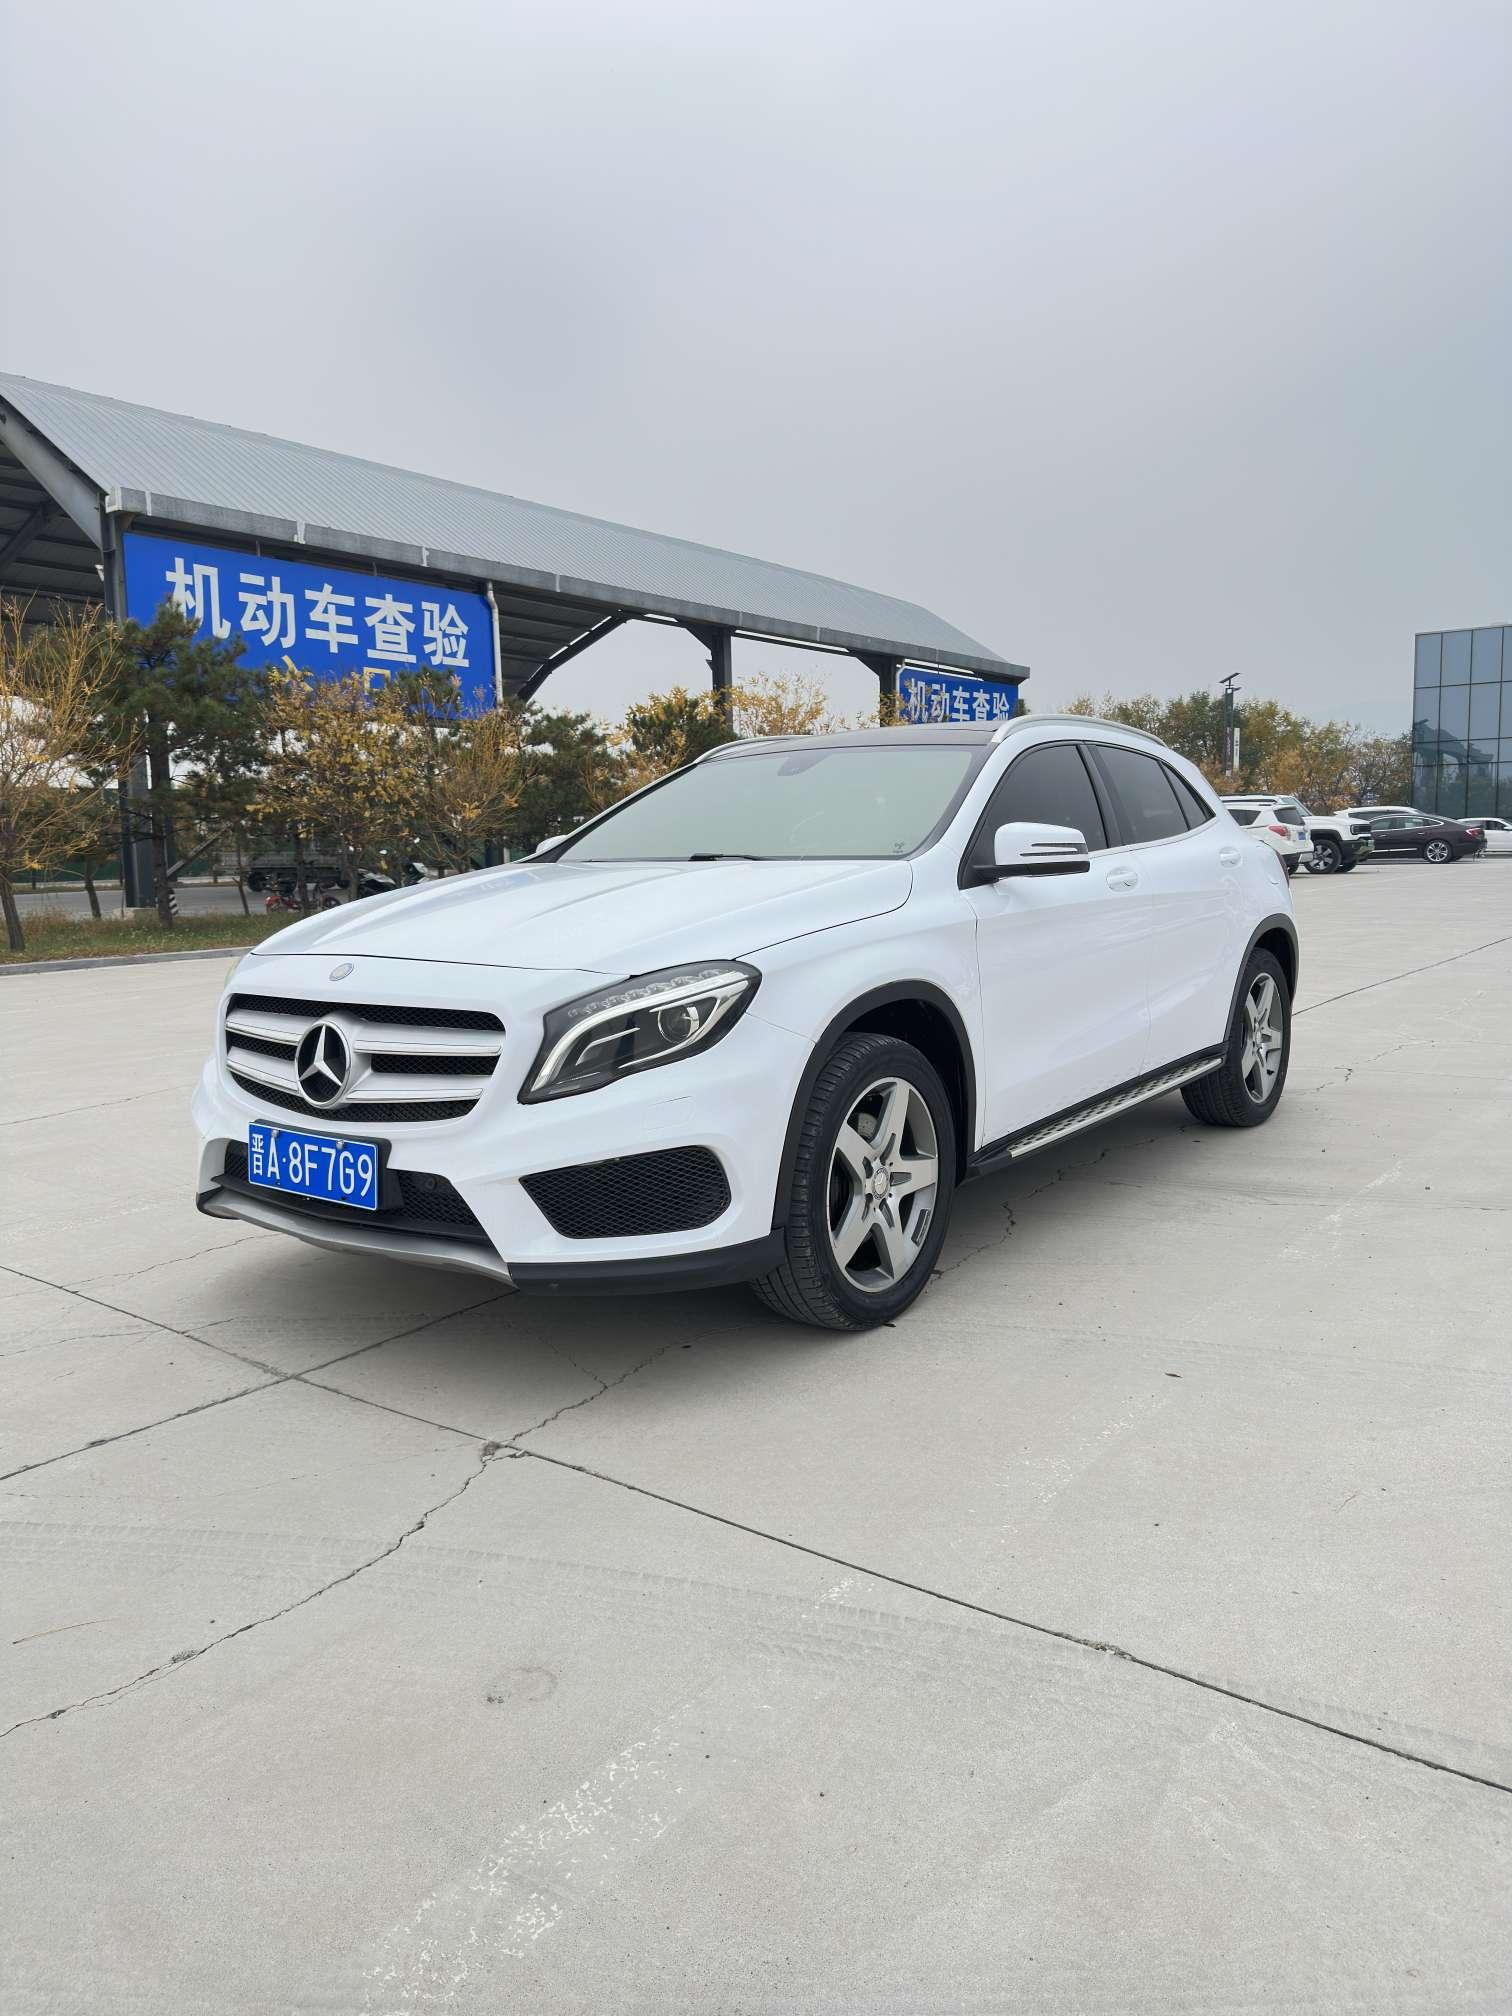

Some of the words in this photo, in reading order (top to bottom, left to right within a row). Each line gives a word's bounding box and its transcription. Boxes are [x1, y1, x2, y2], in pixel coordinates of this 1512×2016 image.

[165, 557, 470, 668] 机动车查验
[908, 677, 1010, 722] 机动车查验
